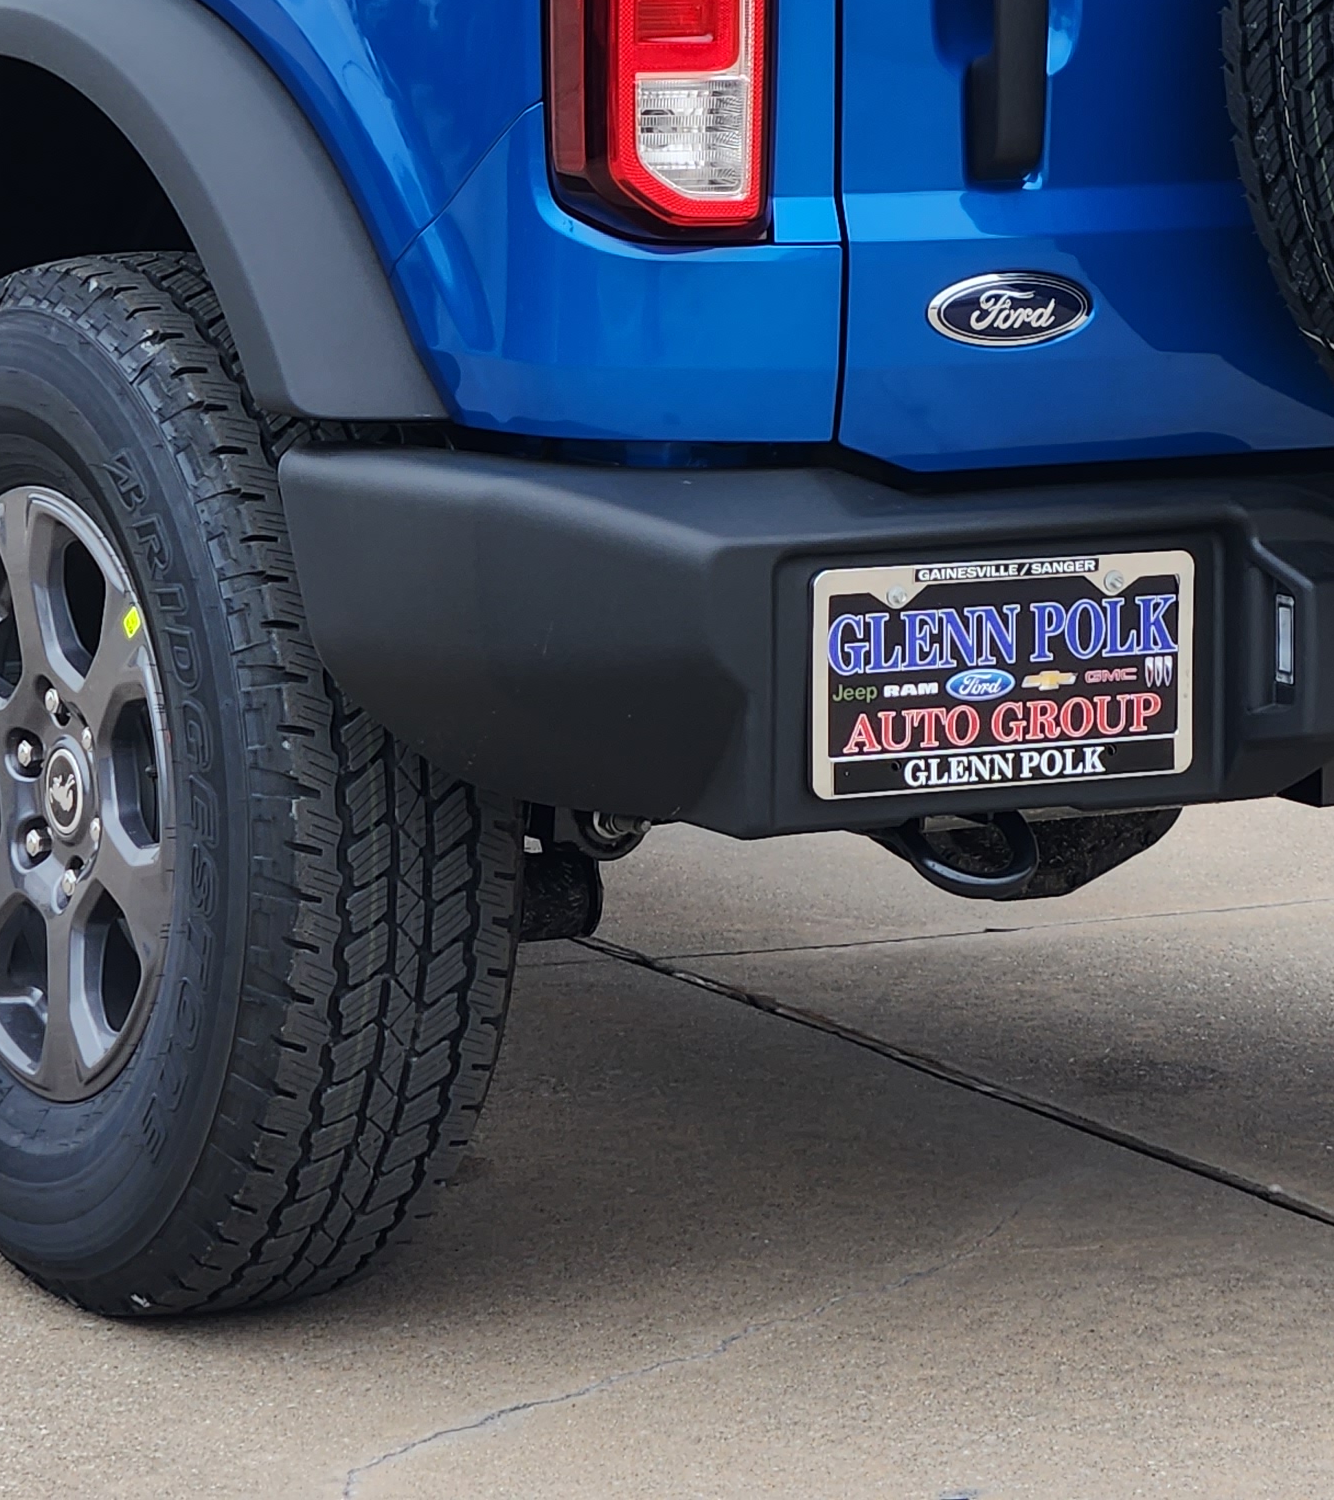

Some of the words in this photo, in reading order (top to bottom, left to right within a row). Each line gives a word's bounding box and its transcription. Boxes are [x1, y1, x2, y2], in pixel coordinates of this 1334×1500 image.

[969, 289, 1056, 331] Ford
[918, 563, 1018, 582] GAINESVILLE
[1031, 559, 1096, 576] SANGER
[827, 603, 1022, 676] GLENN
[1029, 593, 1179, 663] POLK
[832, 684, 878, 704] Jeep
[883, 682, 939, 698] RAM
[958, 670, 1003, 695] Ford
[1084, 667, 1138, 684] GMC
[843, 704, 981, 754] AUTO
[990, 692, 1162, 743] GROUP
[903, 750, 1016, 787] GLENN
[1020, 745, 1107, 779] POLK
[102, 448, 218, 1165] BRIDGESTONE
